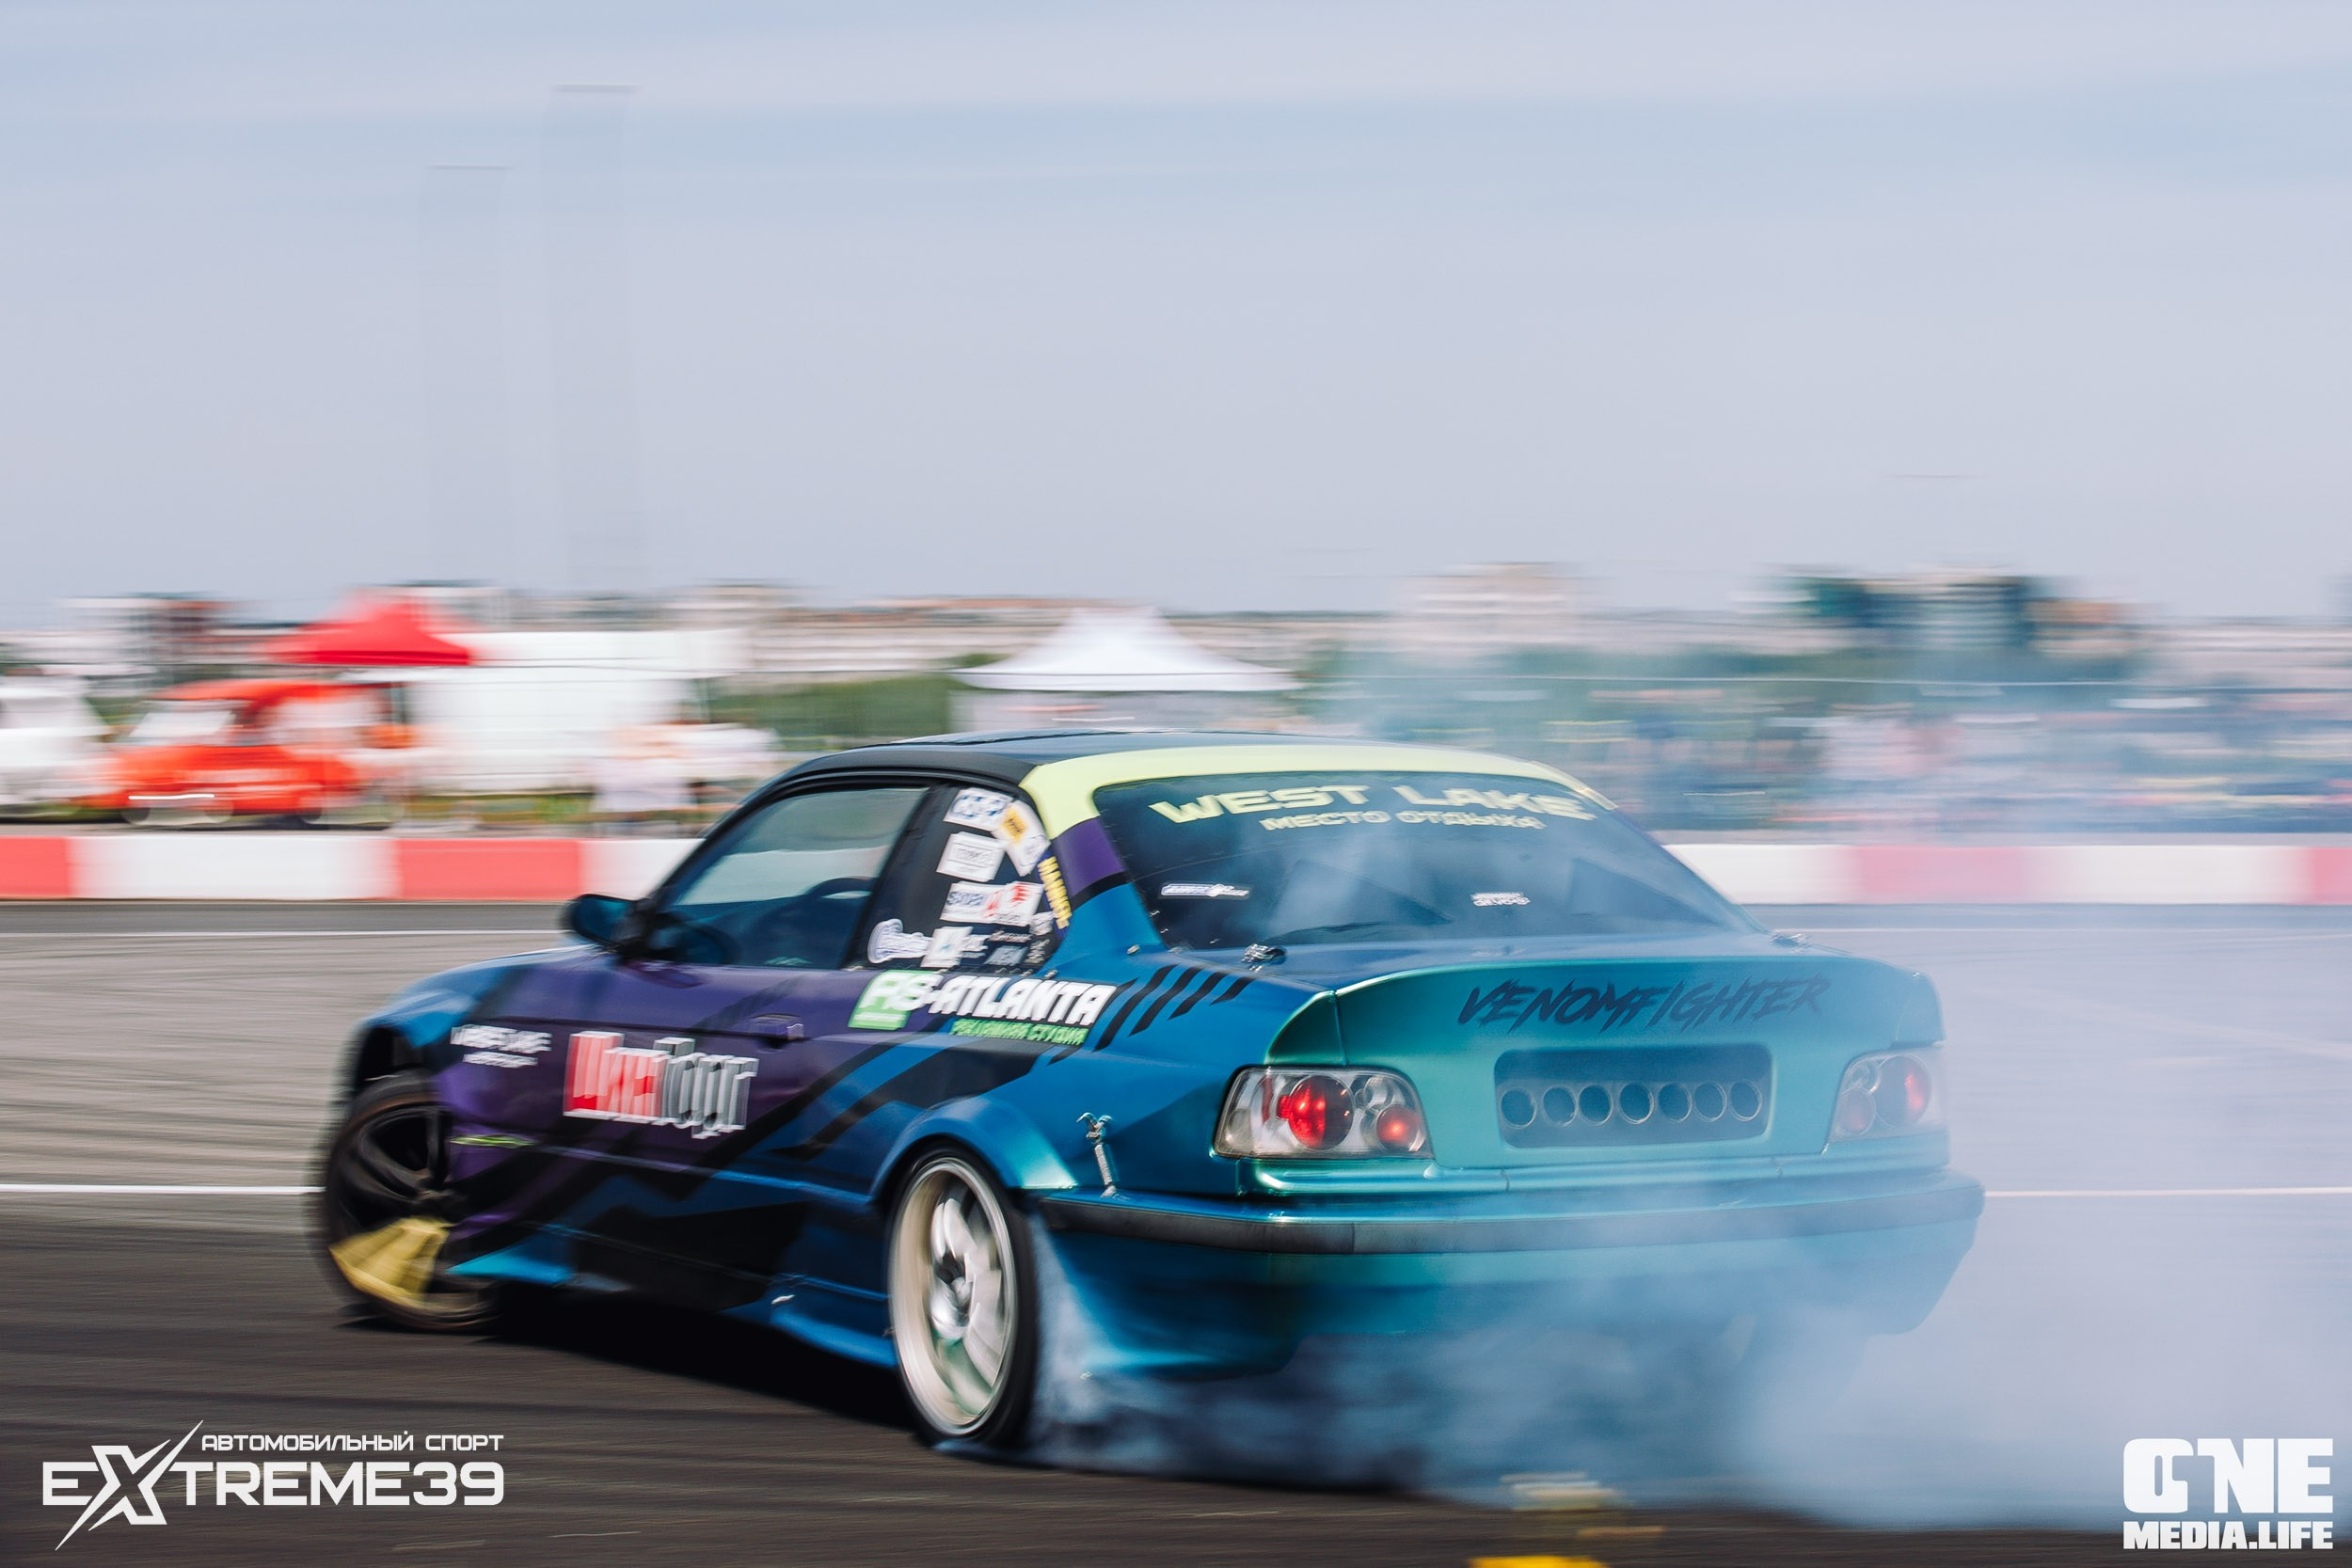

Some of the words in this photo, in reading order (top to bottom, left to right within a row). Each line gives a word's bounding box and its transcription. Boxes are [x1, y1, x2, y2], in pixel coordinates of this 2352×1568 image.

[1148, 785, 1371, 823] WEST
[1391, 785, 1598, 821] LAKE
[1259, 810, 1392, 831] МЕСТО
[1395, 810, 1548, 830] ОТДЫХА
[1457, 973, 1832, 1034] VENOMFIGHTER
